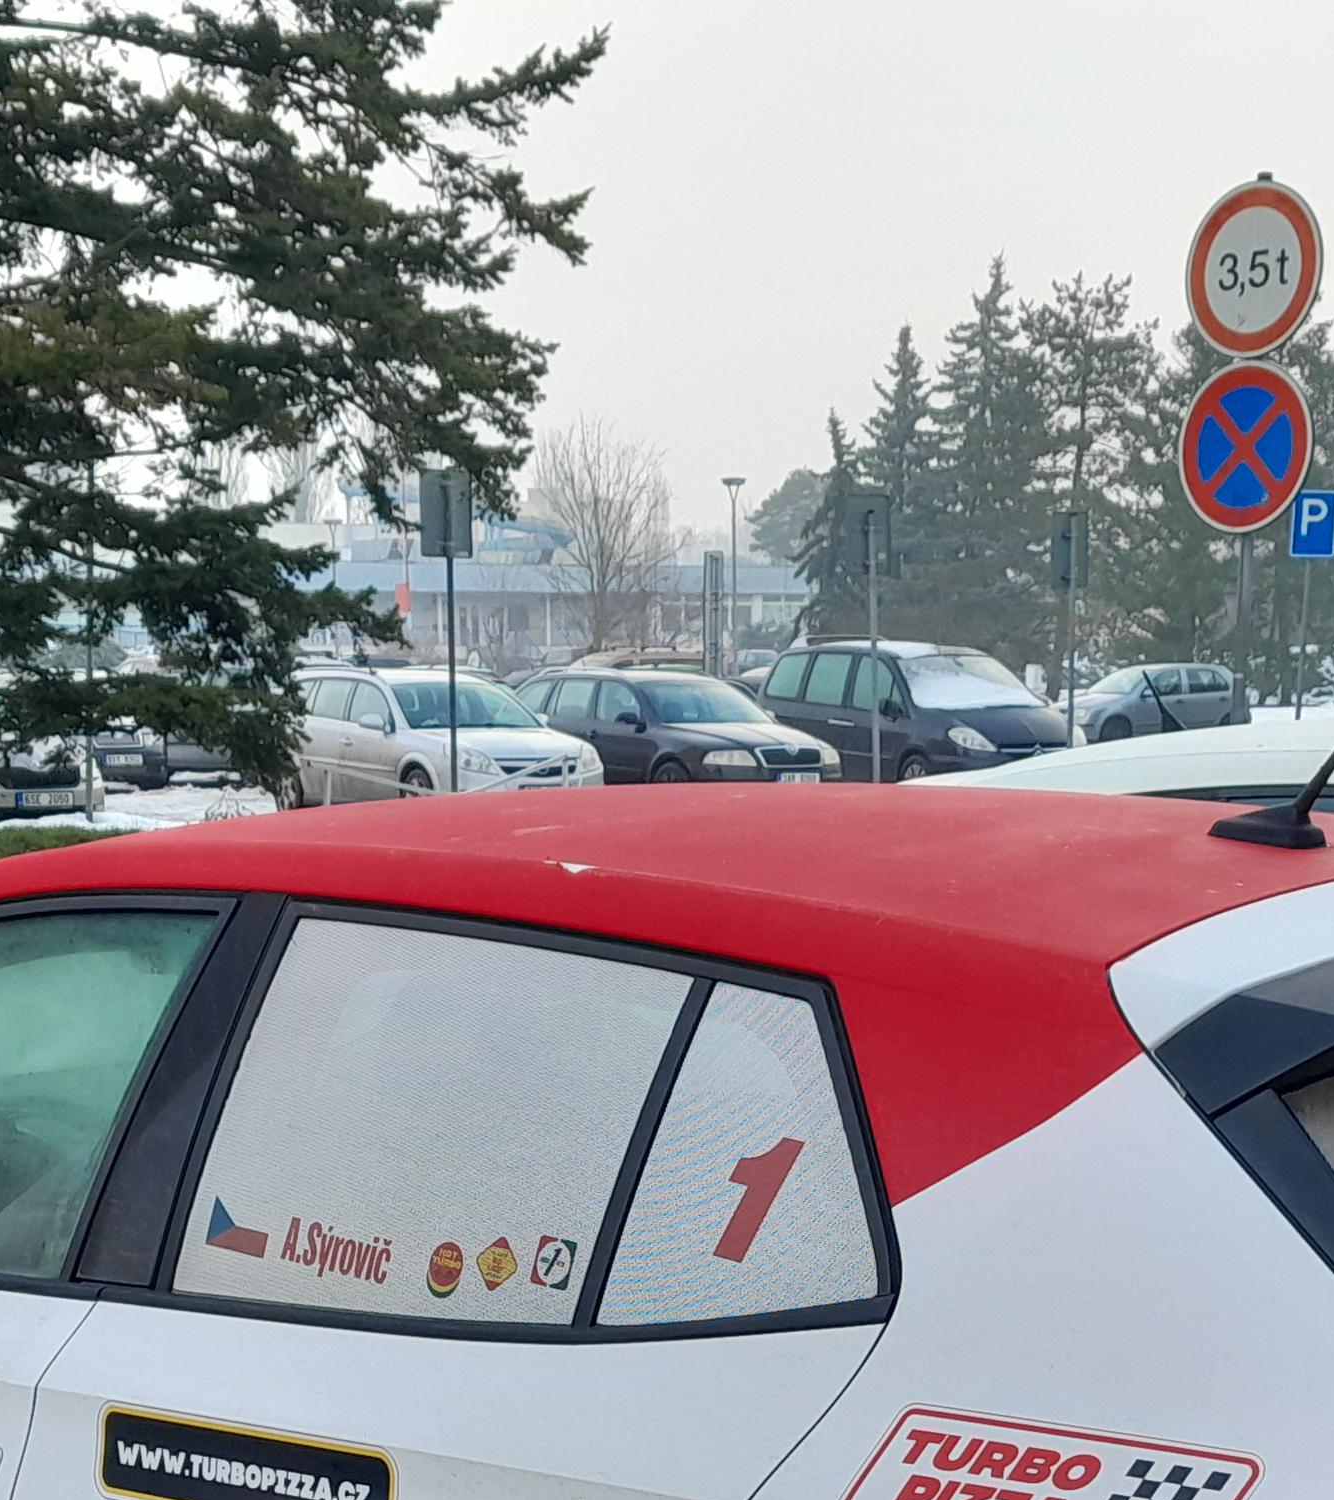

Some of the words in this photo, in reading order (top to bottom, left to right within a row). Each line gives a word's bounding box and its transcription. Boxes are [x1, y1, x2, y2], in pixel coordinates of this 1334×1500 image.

[1300, 498, 1328, 537] P
[713, 1137, 805, 1263] 1
[902, 1429, 1102, 1491] TURBO
